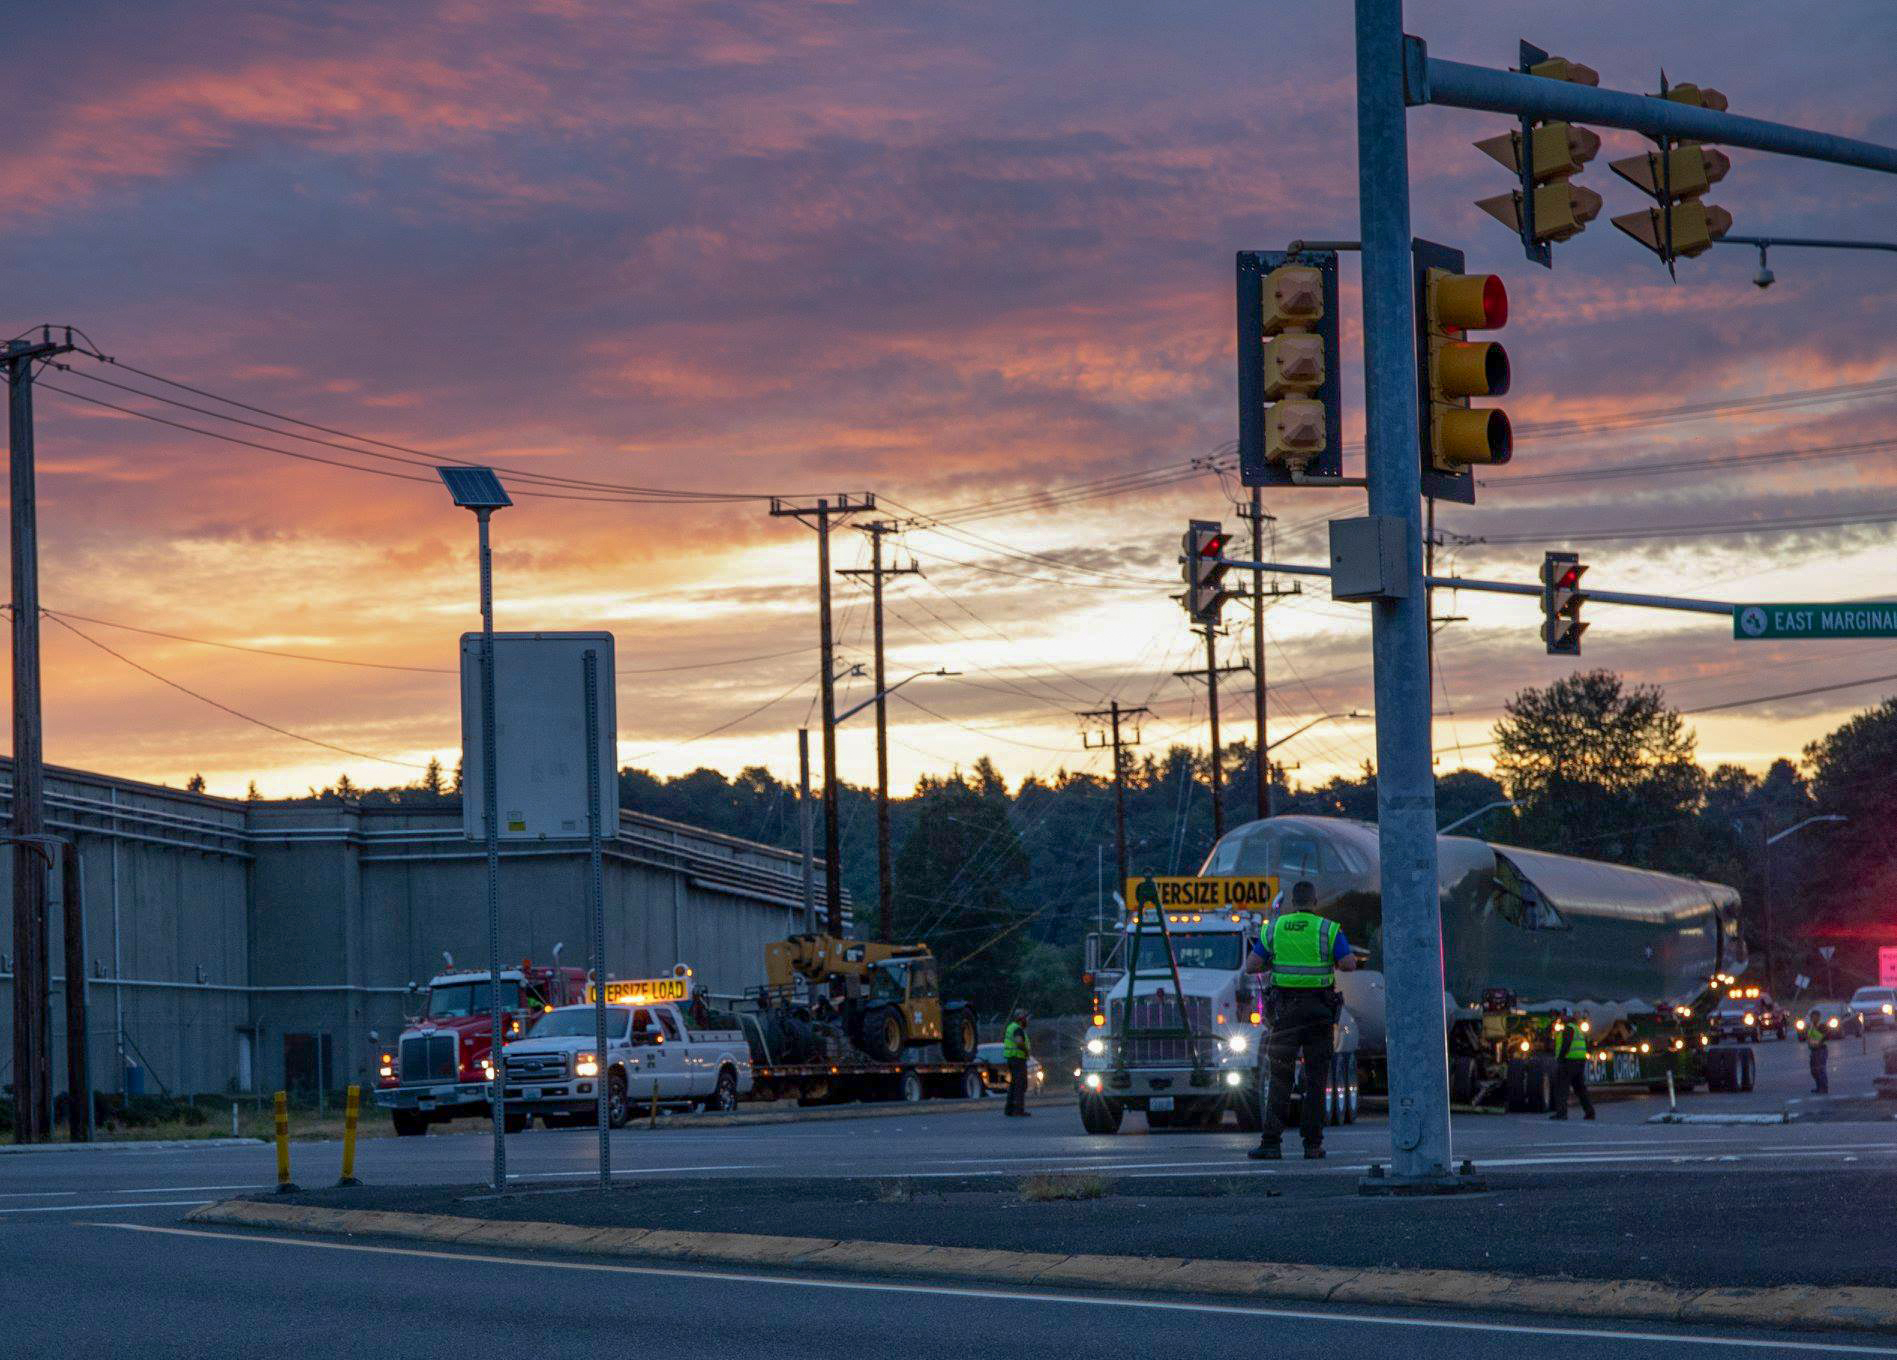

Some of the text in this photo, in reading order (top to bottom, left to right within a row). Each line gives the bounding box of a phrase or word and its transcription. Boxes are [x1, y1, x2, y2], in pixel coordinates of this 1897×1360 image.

[1775, 611, 1814, 631] EAST
[1224, 880, 1271, 904] LOAD
[1285, 920, 1309, 931] WSP
[590, 980, 684, 1003] OERSIZE LOAD
